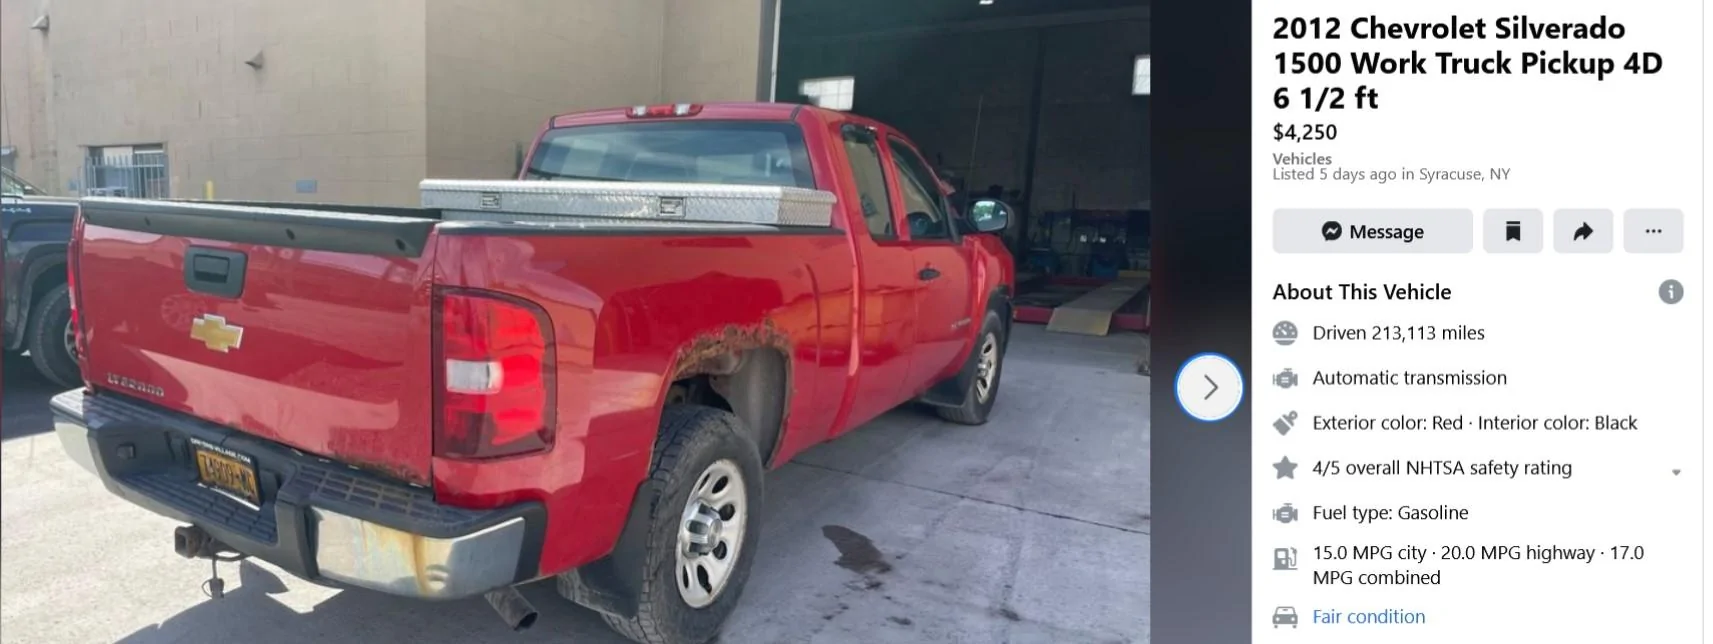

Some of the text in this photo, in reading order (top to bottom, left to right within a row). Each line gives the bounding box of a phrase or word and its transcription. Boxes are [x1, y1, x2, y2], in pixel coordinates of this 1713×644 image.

[1272, 15, 1626, 40] 2012 Chevrolet Silverado
[1274, 50, 1663, 82] 1500 Work Truck Pickup 4D
[1273, 85, 1379, 113] 6 1/2 ft
[1273, 122, 1338, 144] $4,250
[1272, 152, 1333, 166] Vehicles
[1273, 167, 1511, 185] Listed 5 days ago in Syracuse, NY
[1350, 224, 1425, 244] Message
[1272, 282, 1452, 301] About This Vehicle
[1313, 325, 1485, 344] Driven 213,113 miles
[1312, 369, 1507, 386] Automatic transmission
[1313, 414, 1638, 431] Exterior color: Red Interior color: Black
[1312, 460, 1573, 480] 4/5 overall NHTSA safety rating
[1313, 504, 1469, 525] Fuel type: Gasoline
[1313, 545, 1645, 564] 15.0 MPG city 20.0 MPG highway 17.0
[1313, 570, 1441, 585] MPG combined
[1313, 608, 1426, 624] Fair condition
